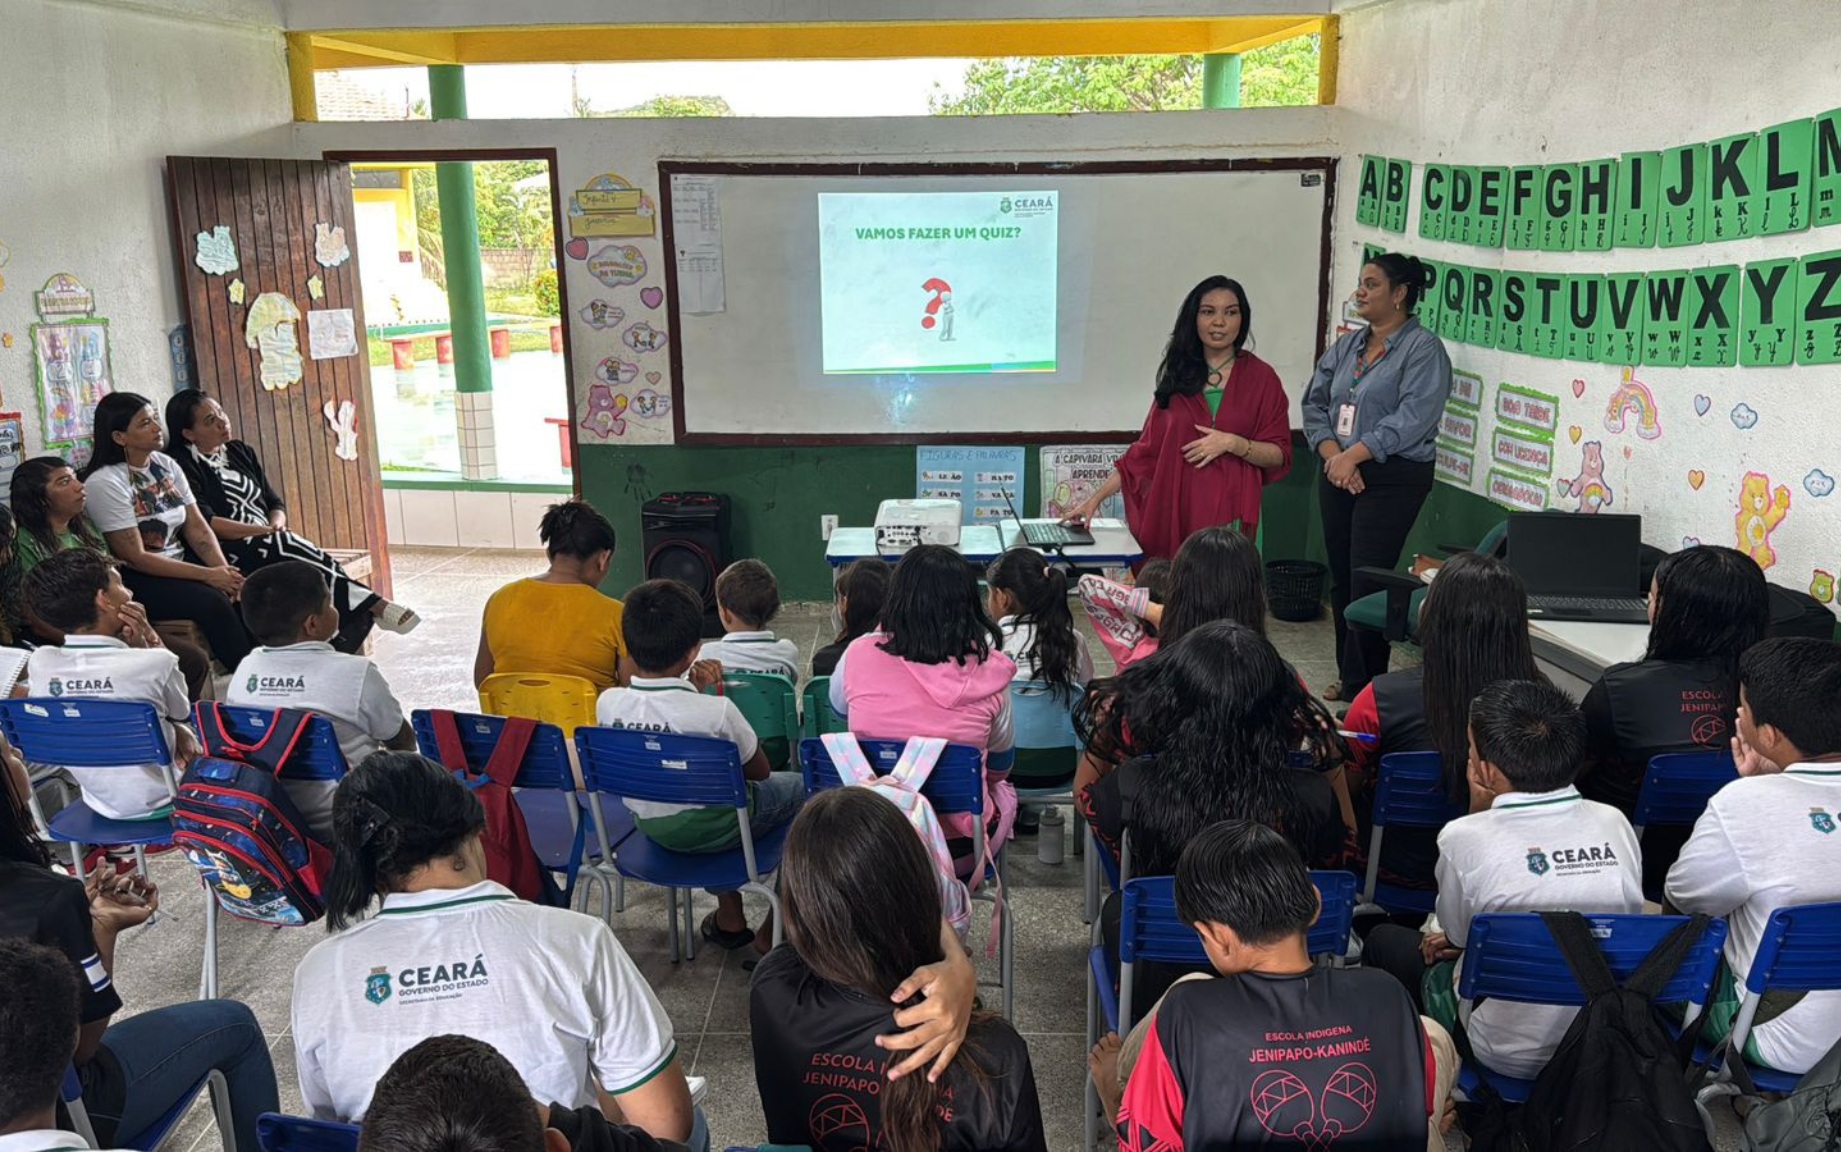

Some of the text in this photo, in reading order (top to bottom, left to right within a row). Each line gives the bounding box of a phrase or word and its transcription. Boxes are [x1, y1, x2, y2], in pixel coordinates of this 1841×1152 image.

[1361, 160, 1377, 199] A
[1387, 162, 1403, 202] B
[1425, 168, 1444, 210] C
[1452, 170, 1471, 212] D
[1480, 171, 1500, 216] E
[1513, 170, 1533, 215] F
[1546, 169, 1571, 218] G
[1581, 164, 1609, 215] H
[1631, 158, 1641, 209] I
[1666, 148, 1693, 206] J
[1712, 138, 1751, 201] K
[1766, 131, 1799, 192] L
[1015, 197, 1053, 208] CEARÁ
[856, 227, 1021, 240] VAMOS FAZER UM QUIZ?
[1419, 256, 1841, 330] P Q R S T U V W X Y Z
[1063, 454, 1103, 464] CAPIVARA
[66, 676, 114, 690] CEARÁ
[260, 675, 305, 688] CEARÁ
[1681, 703, 1727, 712] JENIPAP
[1552, 842, 1617, 864] CEARÁ
[398, 953, 488, 988] CEARÁ
[398, 978, 489, 997] GOVERNO DO ESTADO
[1265, 1030, 1304, 1042] ESCOLA
[1249, 1035, 1372, 1064] JENIPAPO-KANINDÉ
[811, 1052, 876, 1072] ESCOLA
